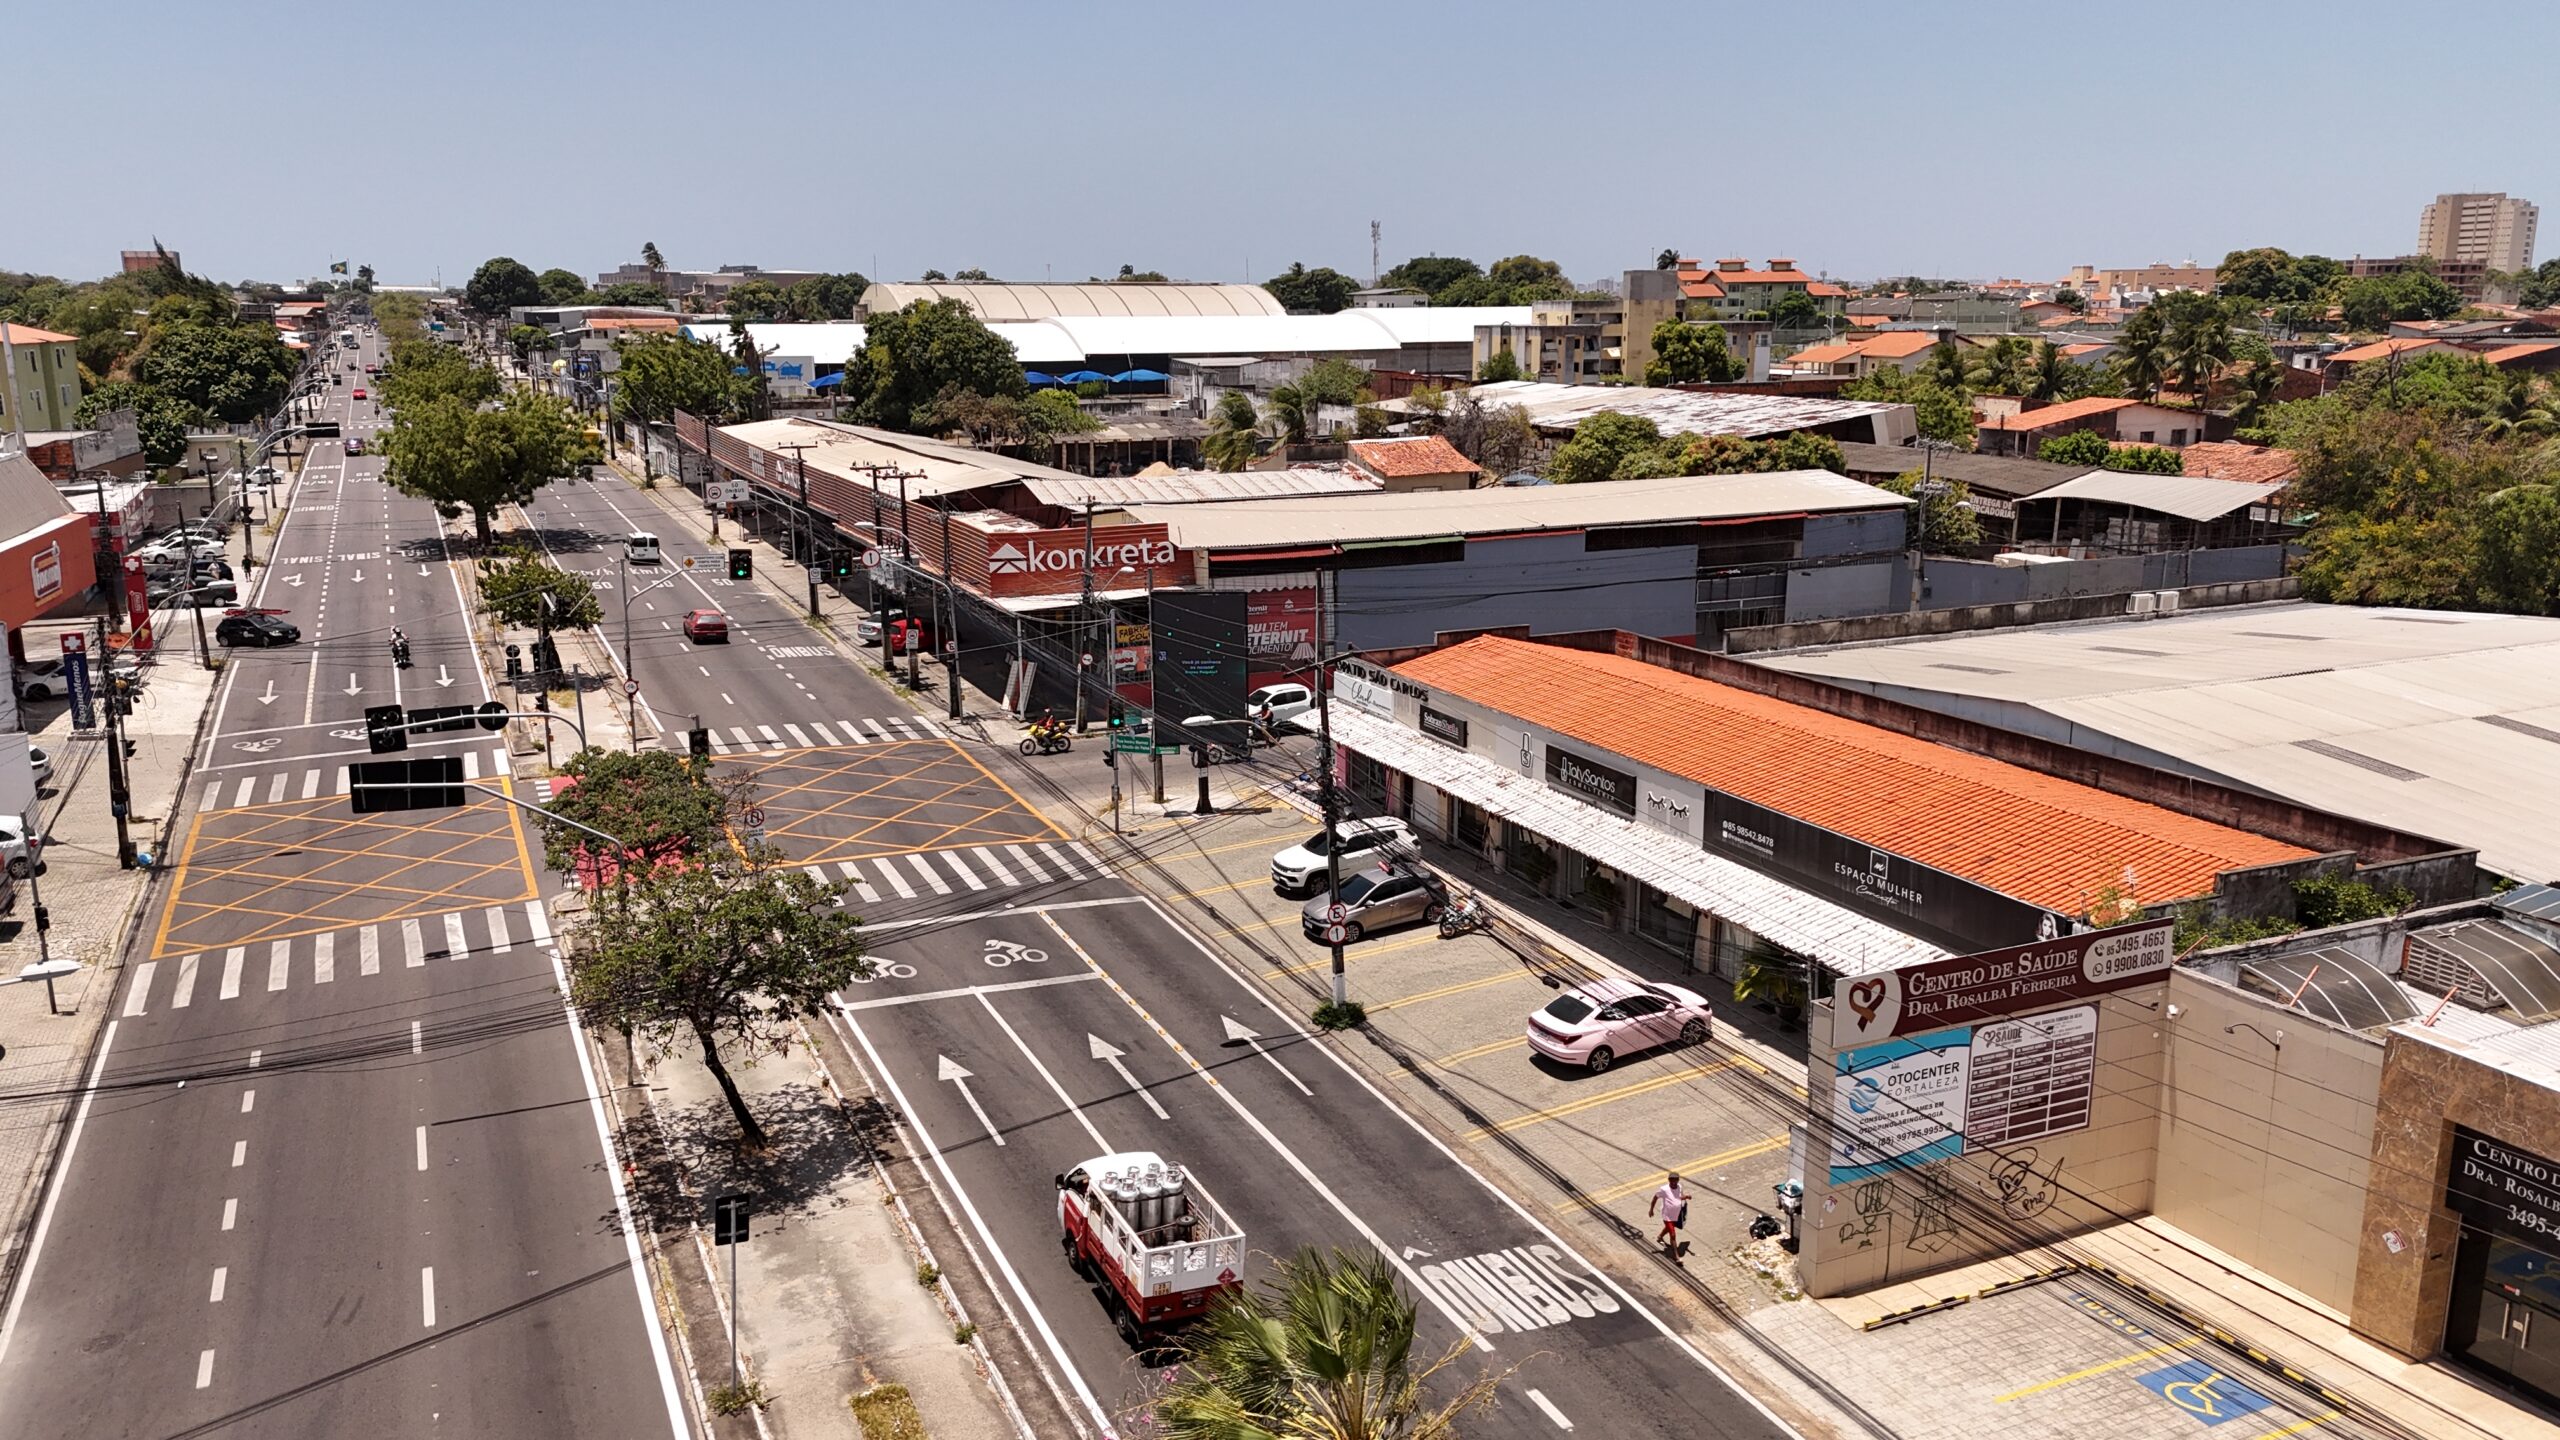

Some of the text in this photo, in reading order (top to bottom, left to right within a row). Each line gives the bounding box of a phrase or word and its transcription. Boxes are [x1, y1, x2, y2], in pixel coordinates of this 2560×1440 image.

[1970, 495, 2013, 510] ENTREGA DE
[1972, 503, 2016, 520] ERCADORIAS
[1027, 537, 1176, 573] konkreta
[1269, 621, 1288, 631] TEM
[765, 644, 836, 658] ÔNIBUS
[1390, 678, 1429, 703] CARLOS
[1834, 862, 1923, 905] ESPAÇO MULHER
[2106, 931, 2166, 956] 85 3495.4663
[1908, 948, 2078, 996] CENTRO DE SAÚDE
[2105, 949, 2164, 975] 9 9908.0830
[1907, 974, 2078, 1018] DRA. ROSALBA FERREIRA
[1887, 1061, 1960, 1087] OTOCENTER
[1887, 1075, 1959, 1098] FORTALEZA
[2463, 1159, 2499, 1187] DRA.
[2473, 1139, 2548, 1181] CENTRO
[1402, 1244, 1621, 1334] ÔNIBUS
